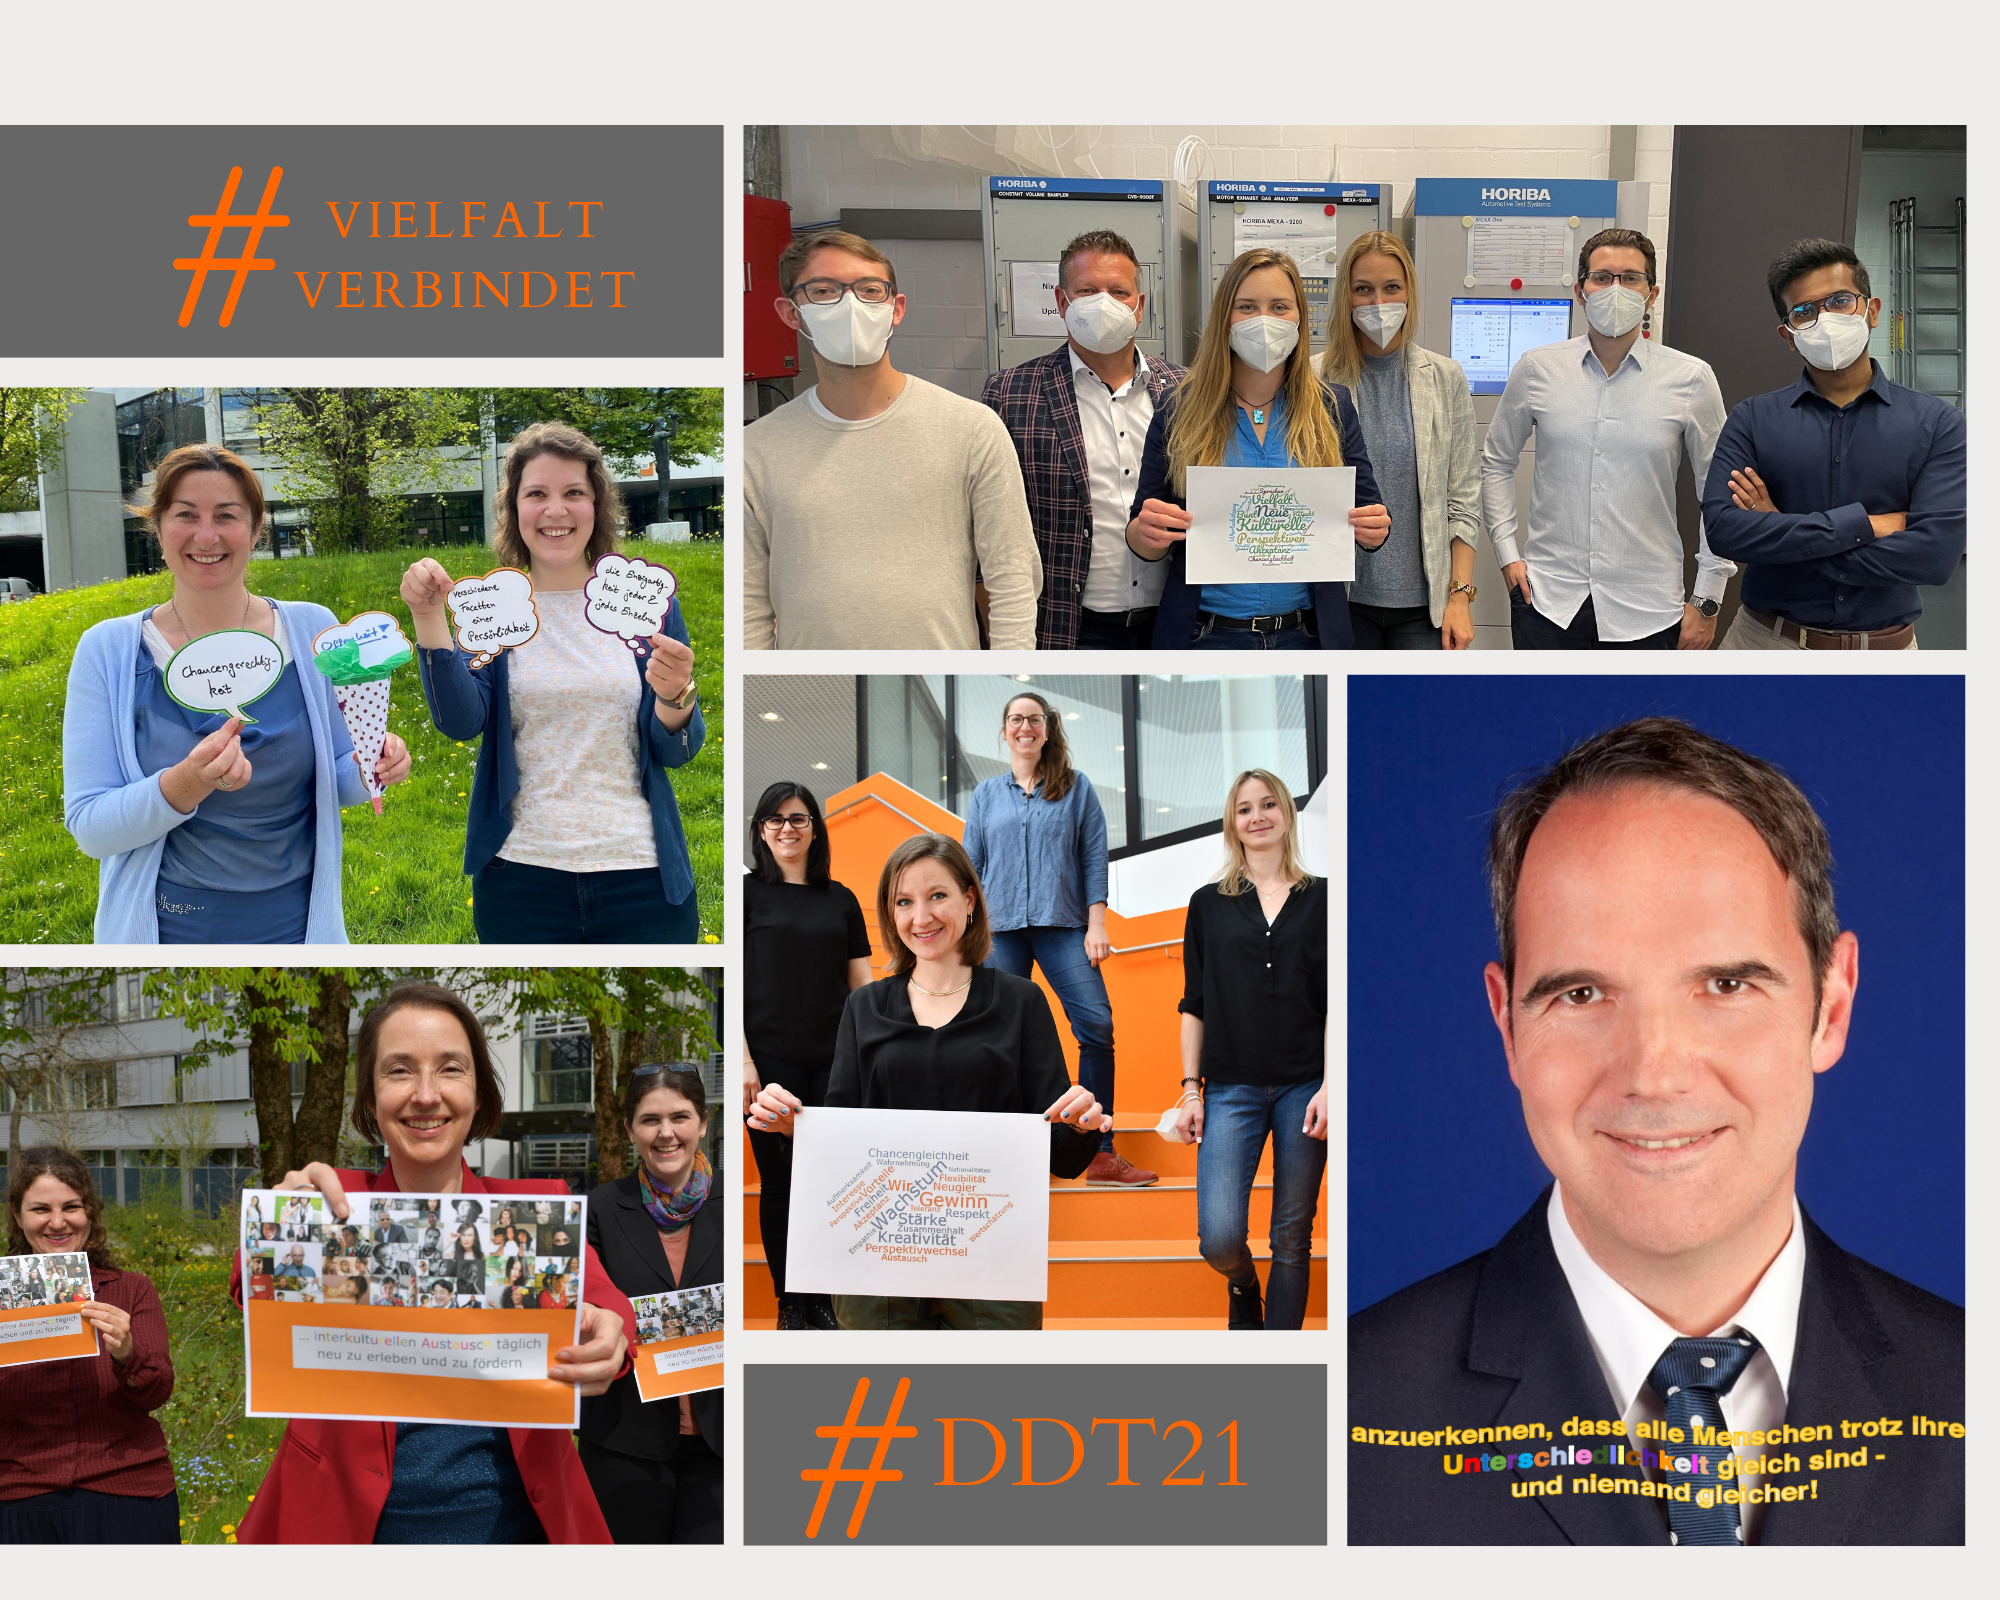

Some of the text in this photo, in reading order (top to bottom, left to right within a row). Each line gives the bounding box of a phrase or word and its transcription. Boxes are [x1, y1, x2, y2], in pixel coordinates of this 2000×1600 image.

[998, 180, 1038, 188] HORIBA
[1216, 184, 1256, 192] HORIBA
[1482, 188, 1551, 200] HORIBA
[1252, 493, 1294, 508] Vielfalt
[1255, 505, 1289, 518] Neue
[1236, 517, 1307, 531] Kulturelle
[1237, 532, 1305, 548] Perspektiven
[606, 566, 620, 576] die
[453, 584, 500, 598] verschiedene
[602, 578, 620, 593] keit
[624, 589, 647, 602] jeder
[459, 600, 496, 612] Facetten
[595, 599, 617, 612] jedes
[472, 616, 493, 624] einer
[468, 622, 530, 642] Persönlichkeit
[207, 679, 232, 698] keit
[868, 1148, 970, 1162] Chancengleichheit
[876, 1158, 930, 1168] Wahrnehmung
[826, 1161, 873, 1207] Aufmerksamkeit
[860, 1164, 896, 1198] Vorteile
[888, 1179, 913, 1192] Wir
[939, 1174, 987, 1183] Flexibilität
[933, 1182, 977, 1194] Neugier
[832, 1180, 866, 1212] Interesse
[854, 1183, 889, 1218] Freiheit
[870, 1160, 948, 1231] Wachstum
[919, 1192, 988, 1209] Gewinn
[829, 1194, 864, 1228] Perspektive
[853, 1196, 891, 1231] Akzeptanz
[910, 1205, 941, 1213] Toleranz
[946, 1208, 990, 1221] Respekt
[899, 1212, 947, 1227] Stärke
[969, 1201, 1014, 1243] Wertschätzung
[897, 1224, 965, 1235] Zusammenhalt
[849, 1227, 878, 1255] Empathie
[878, 1231, 957, 1246] Kreativität
[865, 1243, 968, 1257] Perspektivwechsel
[881, 1254, 927, 1263] Austausch
[314, 1331, 416, 1348] interkulturellen
[421, 1336, 492, 1351] Austausch
[497, 1338, 541, 1352] täglich
[317, 1350, 522, 1369] neu zu erleben und zu fördern
